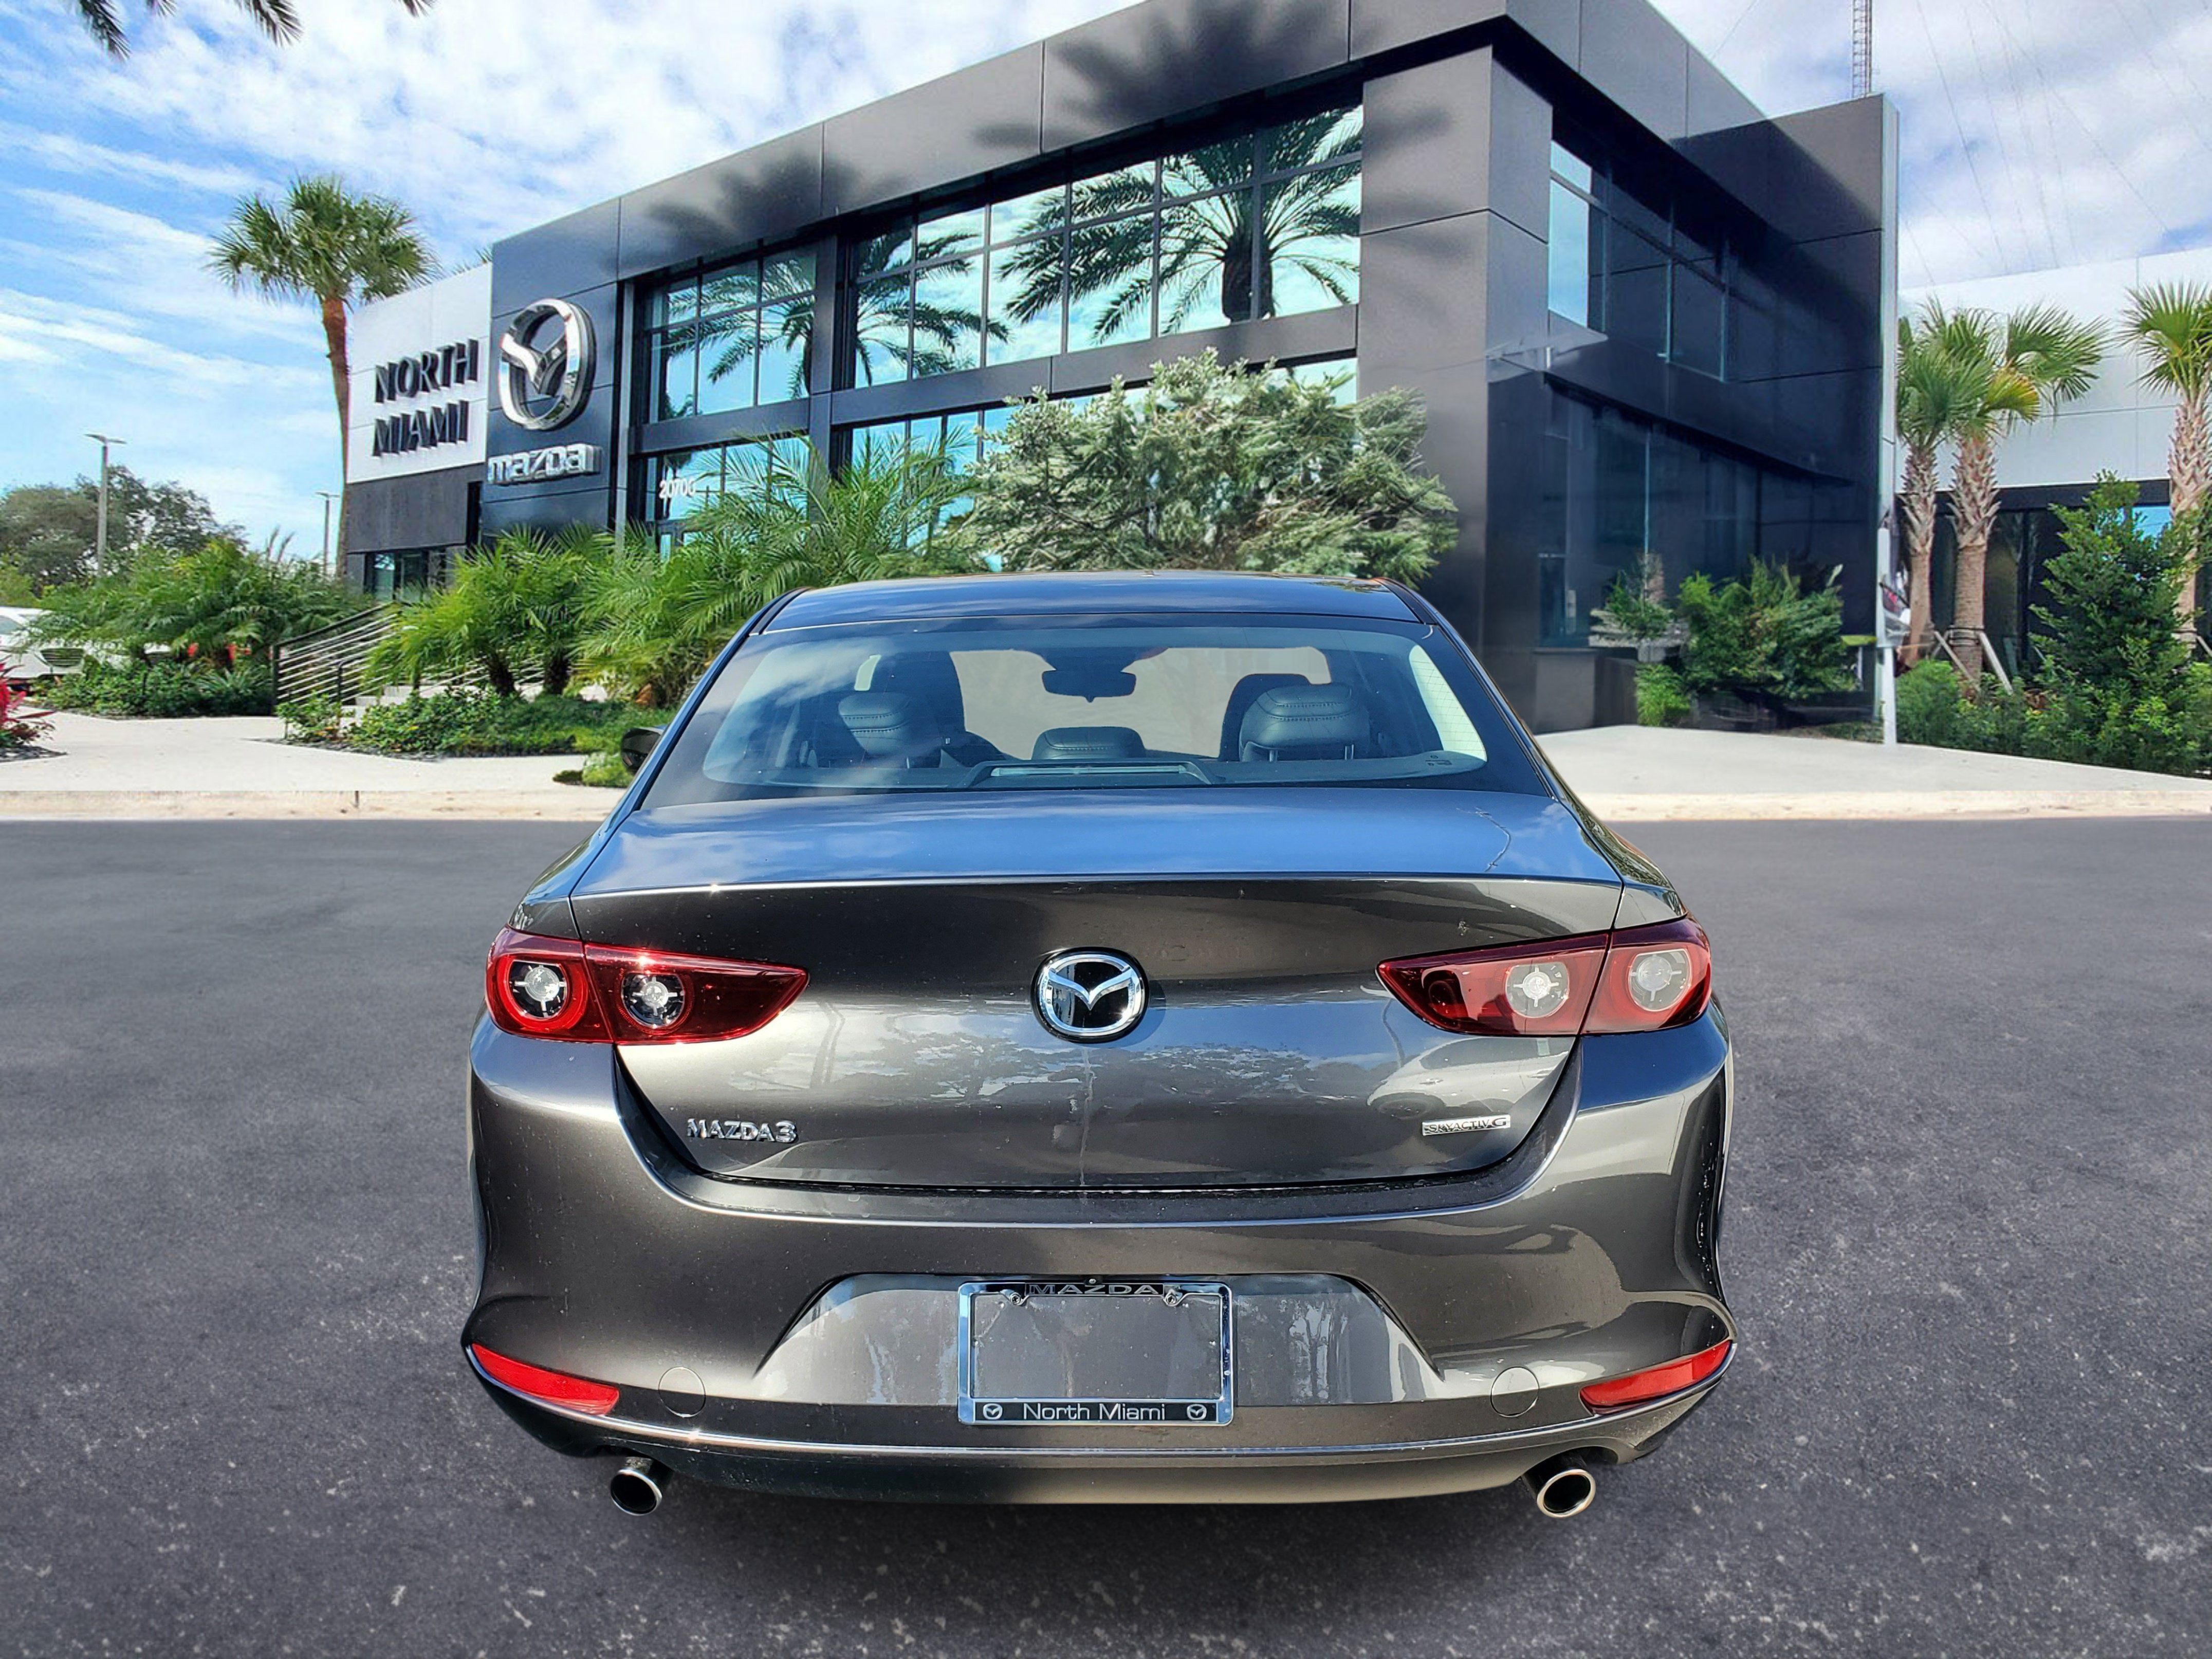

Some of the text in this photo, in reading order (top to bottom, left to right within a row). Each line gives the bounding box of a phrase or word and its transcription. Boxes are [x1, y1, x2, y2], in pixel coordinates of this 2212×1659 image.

[375, 338, 479, 403] NORTH
[372, 400, 470, 457] MIAMI
[1029, 1284, 1159, 1295] MAZDA
[1023, 1403, 1165, 1420] North Miami
